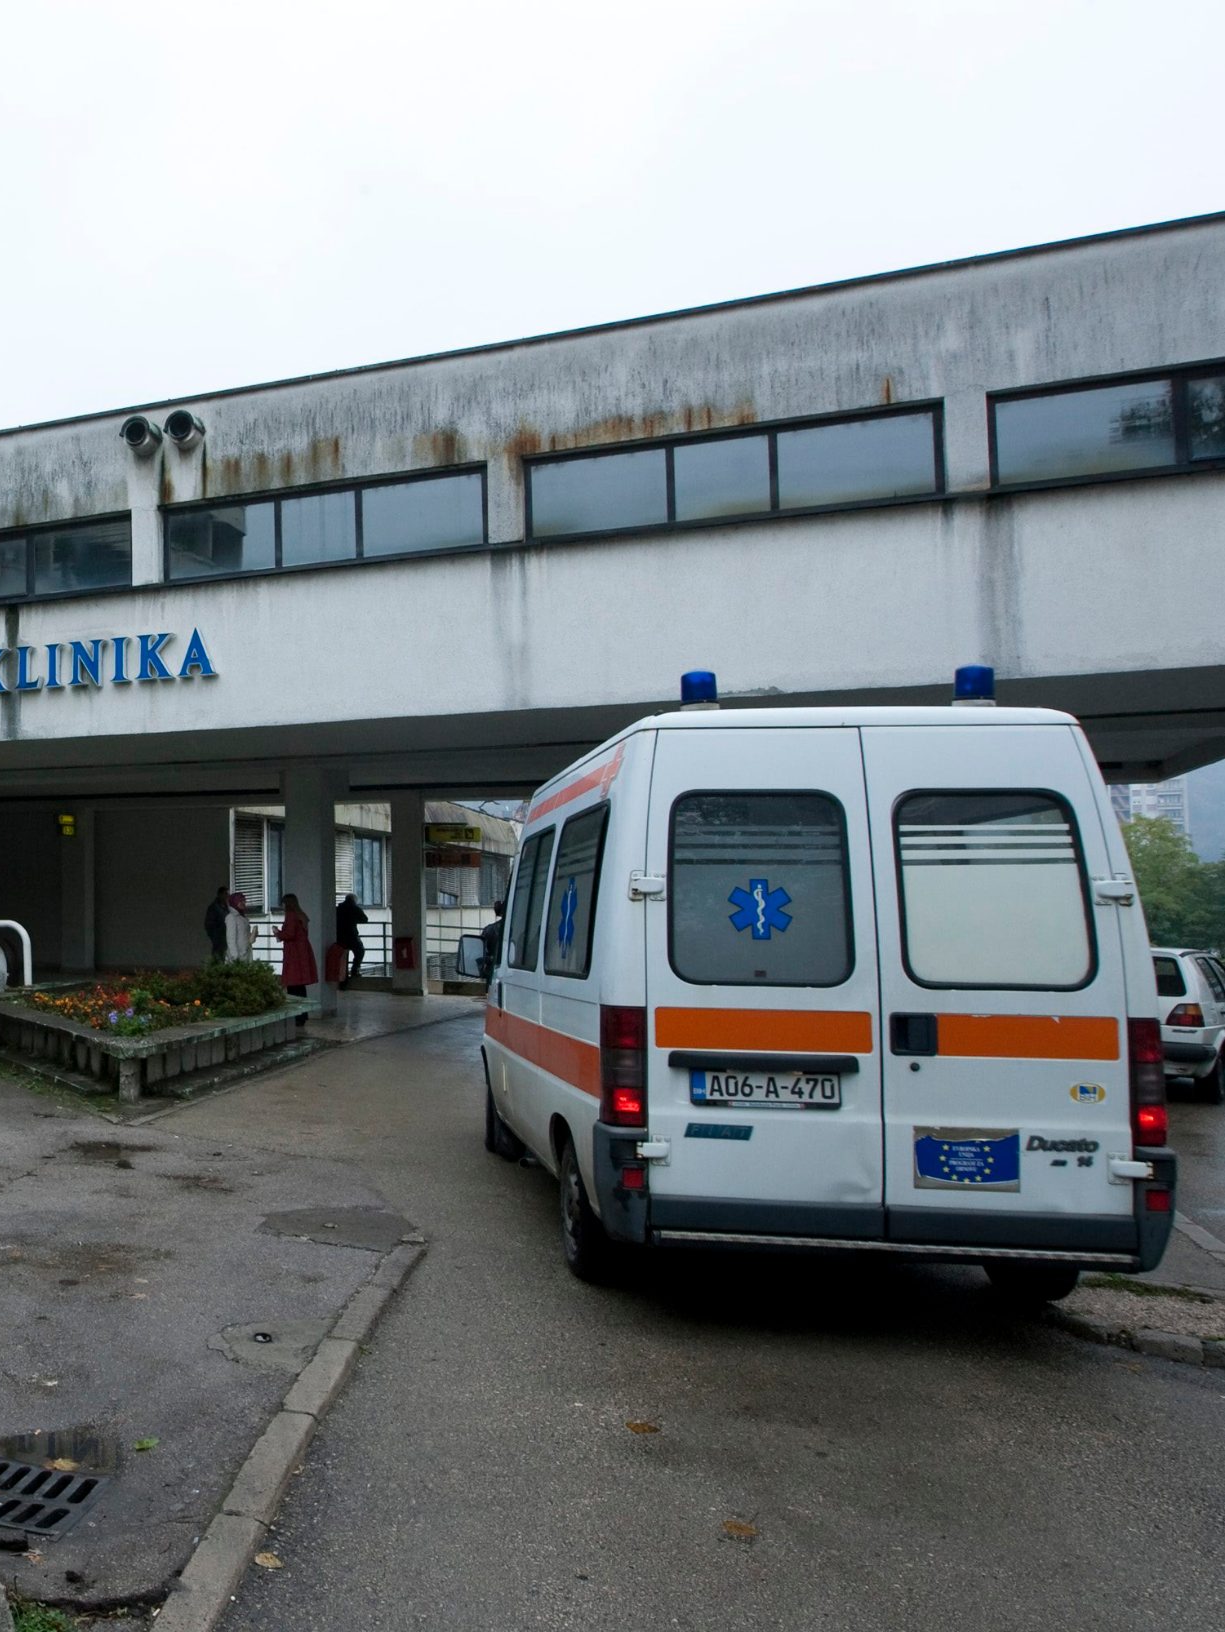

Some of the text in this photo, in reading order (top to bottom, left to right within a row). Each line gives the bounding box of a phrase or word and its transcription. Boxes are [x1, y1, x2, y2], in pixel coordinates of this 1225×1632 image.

[709, 1075, 836, 1100] A06-A-470
[690, 1124, 750, 1138] FIAT
[1026, 1135, 1100, 1152] Ducato
